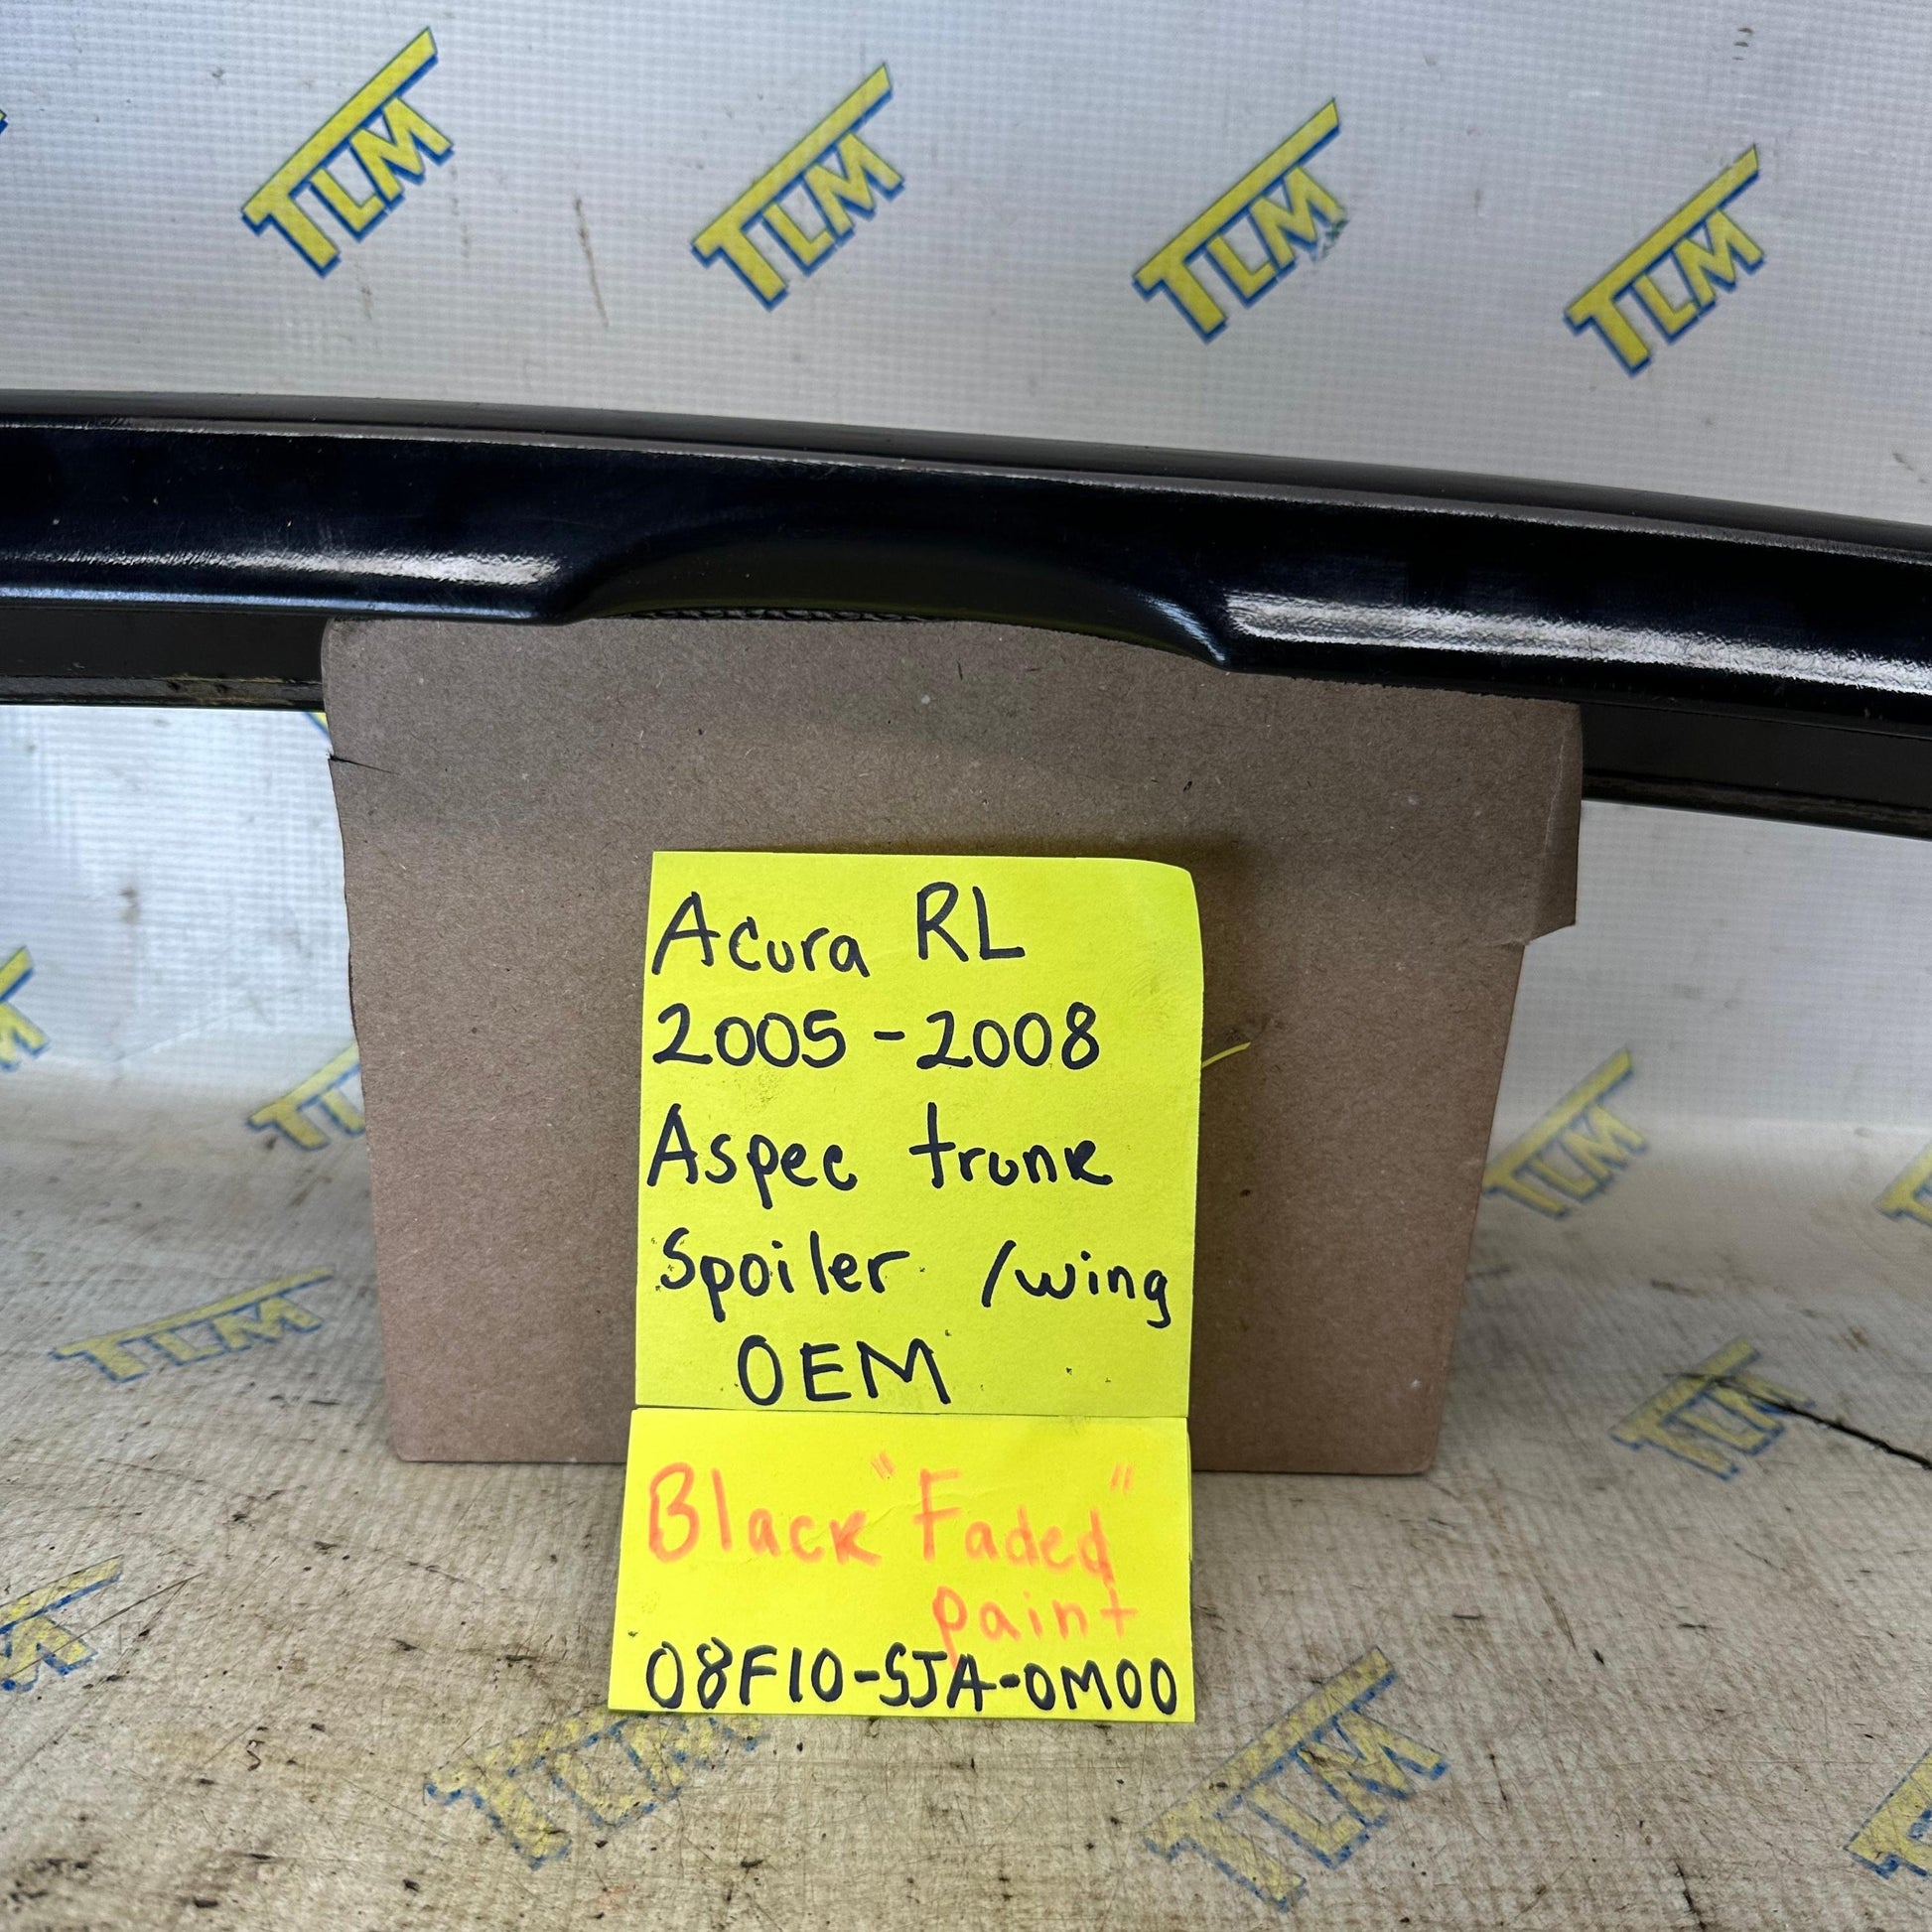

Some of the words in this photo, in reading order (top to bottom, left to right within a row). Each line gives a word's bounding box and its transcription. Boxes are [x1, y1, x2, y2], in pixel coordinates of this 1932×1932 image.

[241, 26, 455, 278] TLM
[690, 63, 904, 311] TLM
[1132, 96, 1348, 345] TLM
[1564, 143, 1764, 378] TLM
[651, 891, 870, 977] Acura
[916, 881, 1026, 963] RL
[647, 1103, 859, 1210] Aspec
[1483, 1045, 1647, 1221] TLM
[48, 1264, 336, 1383] TLM
[737, 1334, 951, 1406] OEM
[647, 1461, 882, 1567] Black
[1143, 1646, 1449, 1911] TLM
